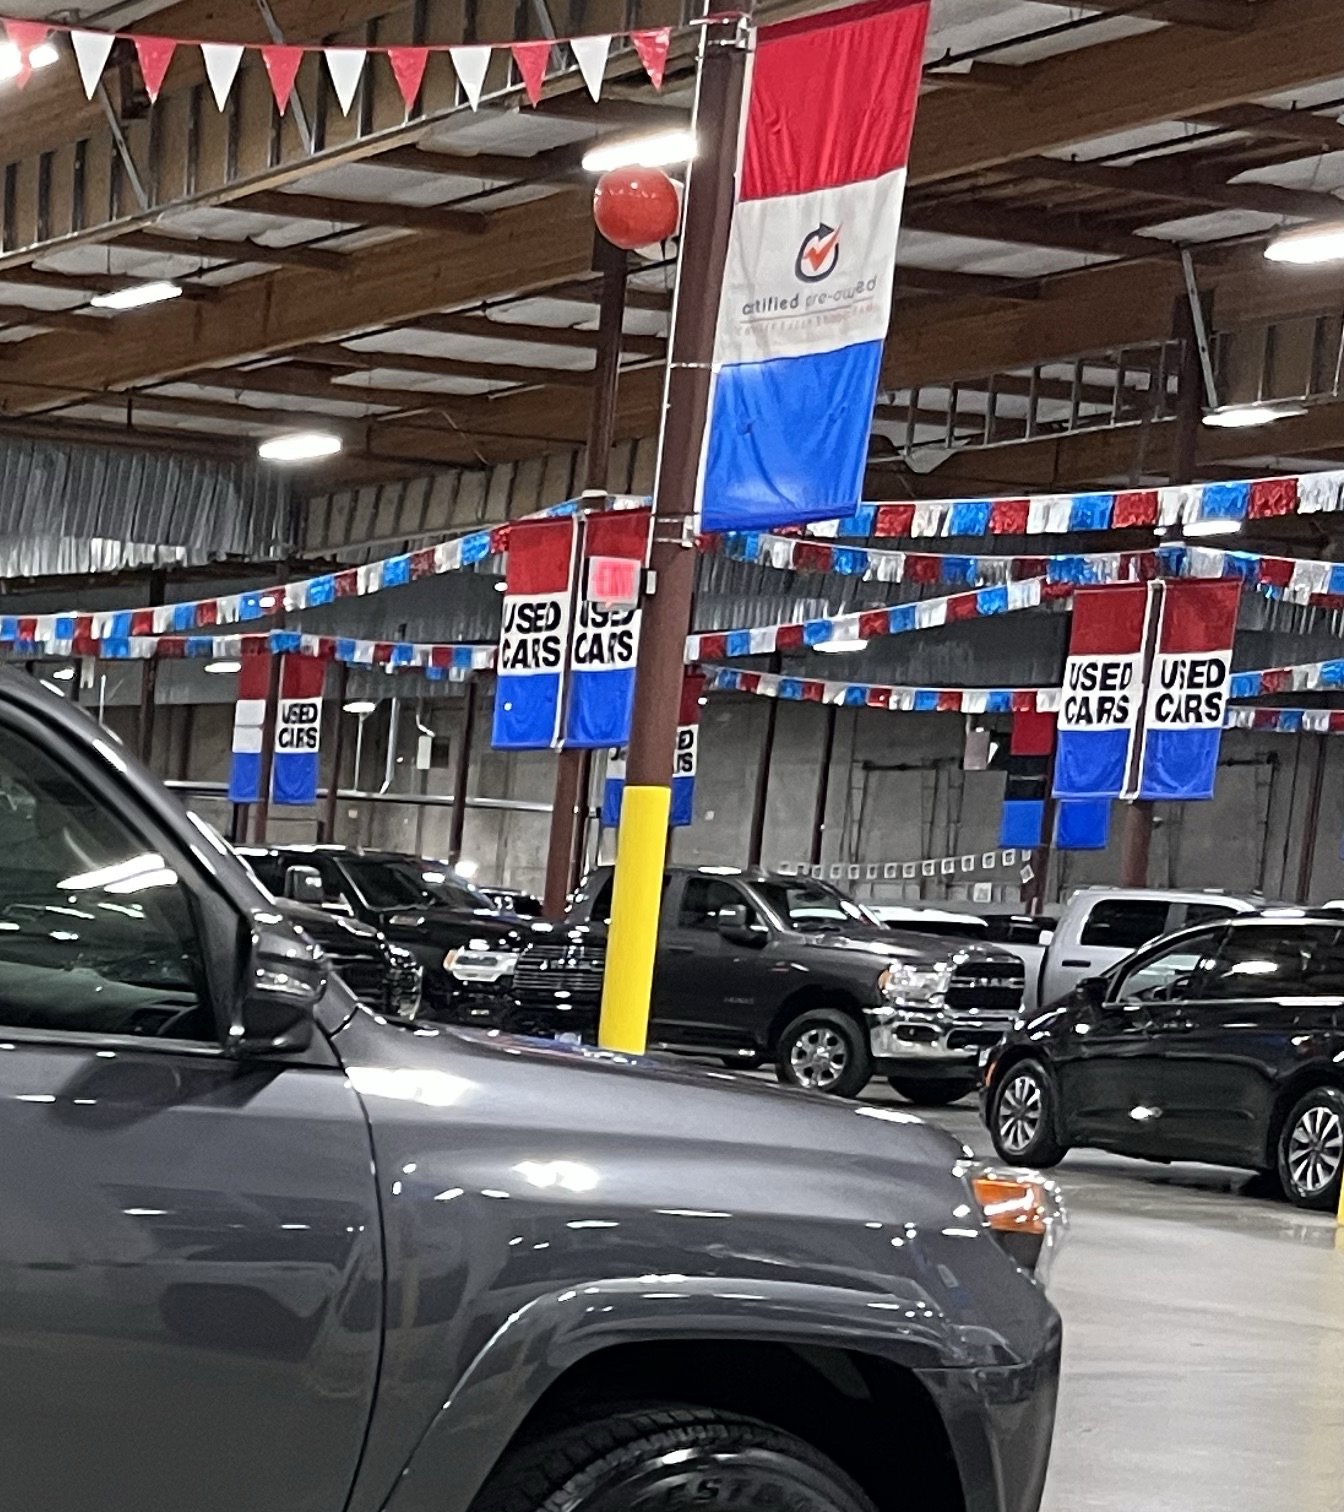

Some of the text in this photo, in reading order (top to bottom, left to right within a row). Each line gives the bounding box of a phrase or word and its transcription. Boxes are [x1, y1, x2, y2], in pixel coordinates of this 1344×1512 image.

[504, 601, 562, 634] USED
[502, 636, 561, 669] CARS
[574, 630, 633, 664] CARS
[1070, 662, 1133, 691] USED
[1162, 658, 1226, 690] USED
[282, 702, 318, 724] USED
[1064, 694, 1130, 725] CARS
[1155, 691, 1223, 723] CARS
